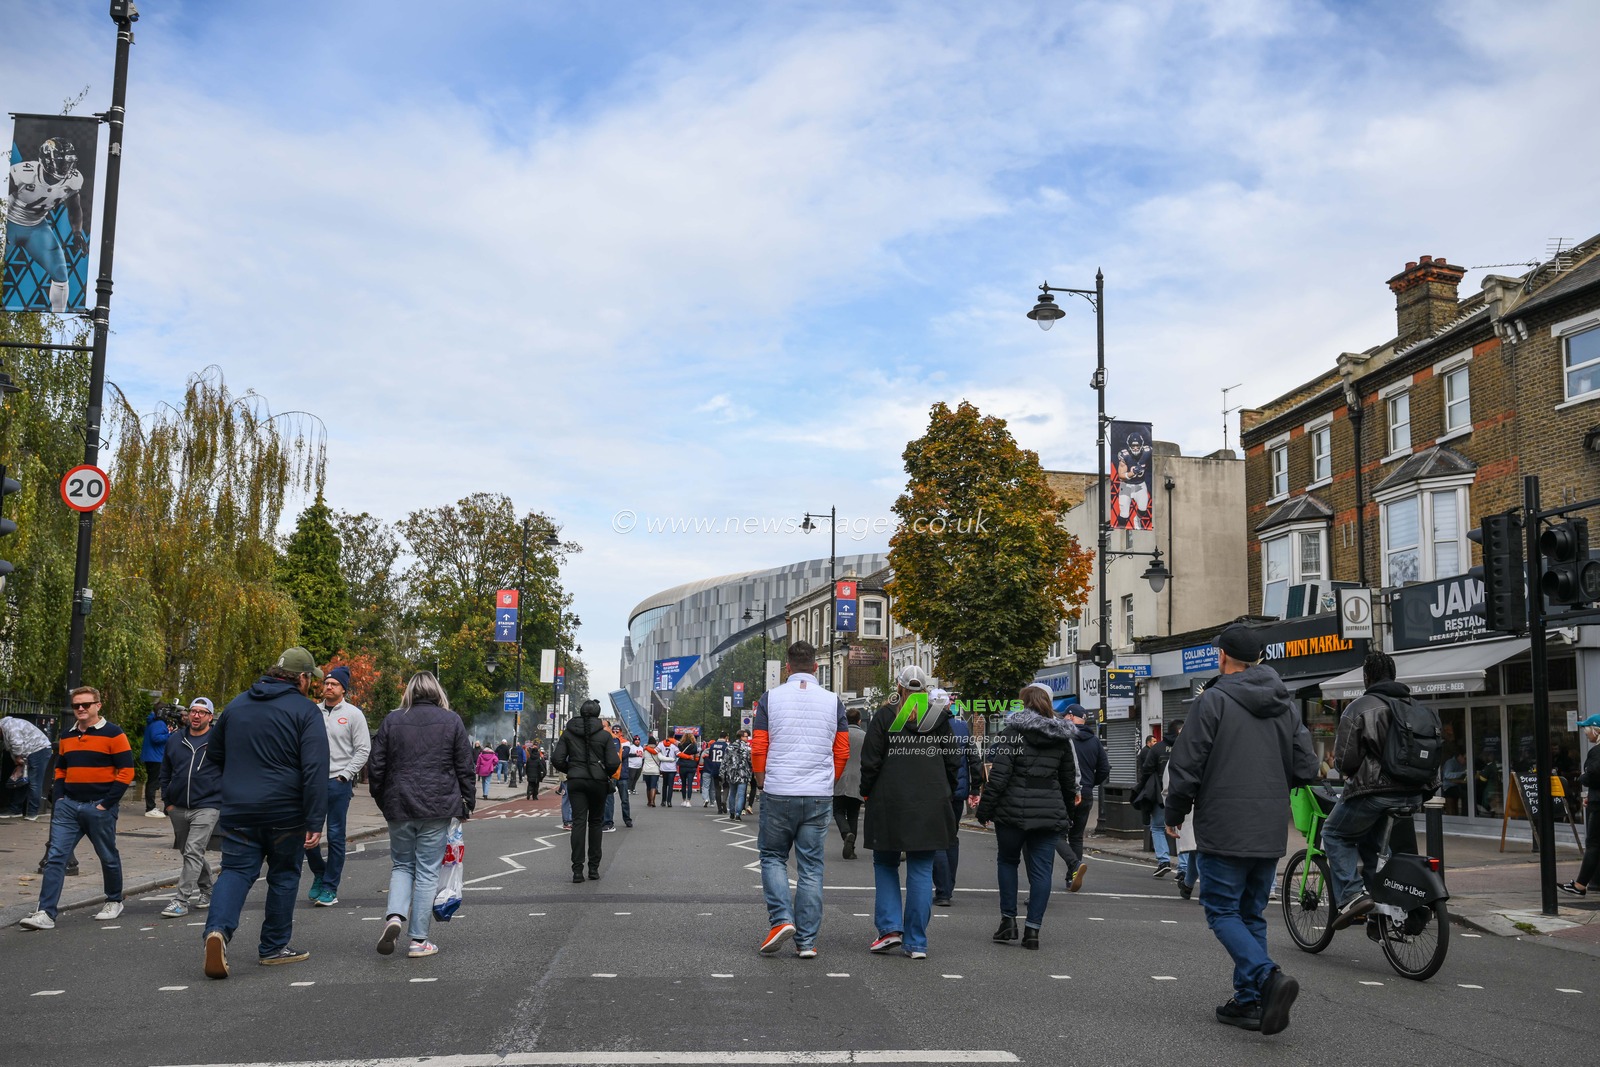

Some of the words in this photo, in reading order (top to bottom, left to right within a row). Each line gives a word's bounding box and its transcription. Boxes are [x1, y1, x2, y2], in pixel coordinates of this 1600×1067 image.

[69, 478, 103, 498] 20
[1429, 578, 1485, 618] JAM
[1349, 599, 1361, 622] J
[1184, 648, 1205, 660] COLLINS
[1265, 642, 1285, 661] SUN
[1285, 639, 1309, 657] MINI
[1412, 685, 1422, 693] TEA
[1427, 683, 1446, 692] COFFEE
[1451, 683, 1465, 691] BEER
[665, 747, 671, 758] 7
[712, 749, 723, 762] 12
[1409, 885, 1426, 898] Uber
